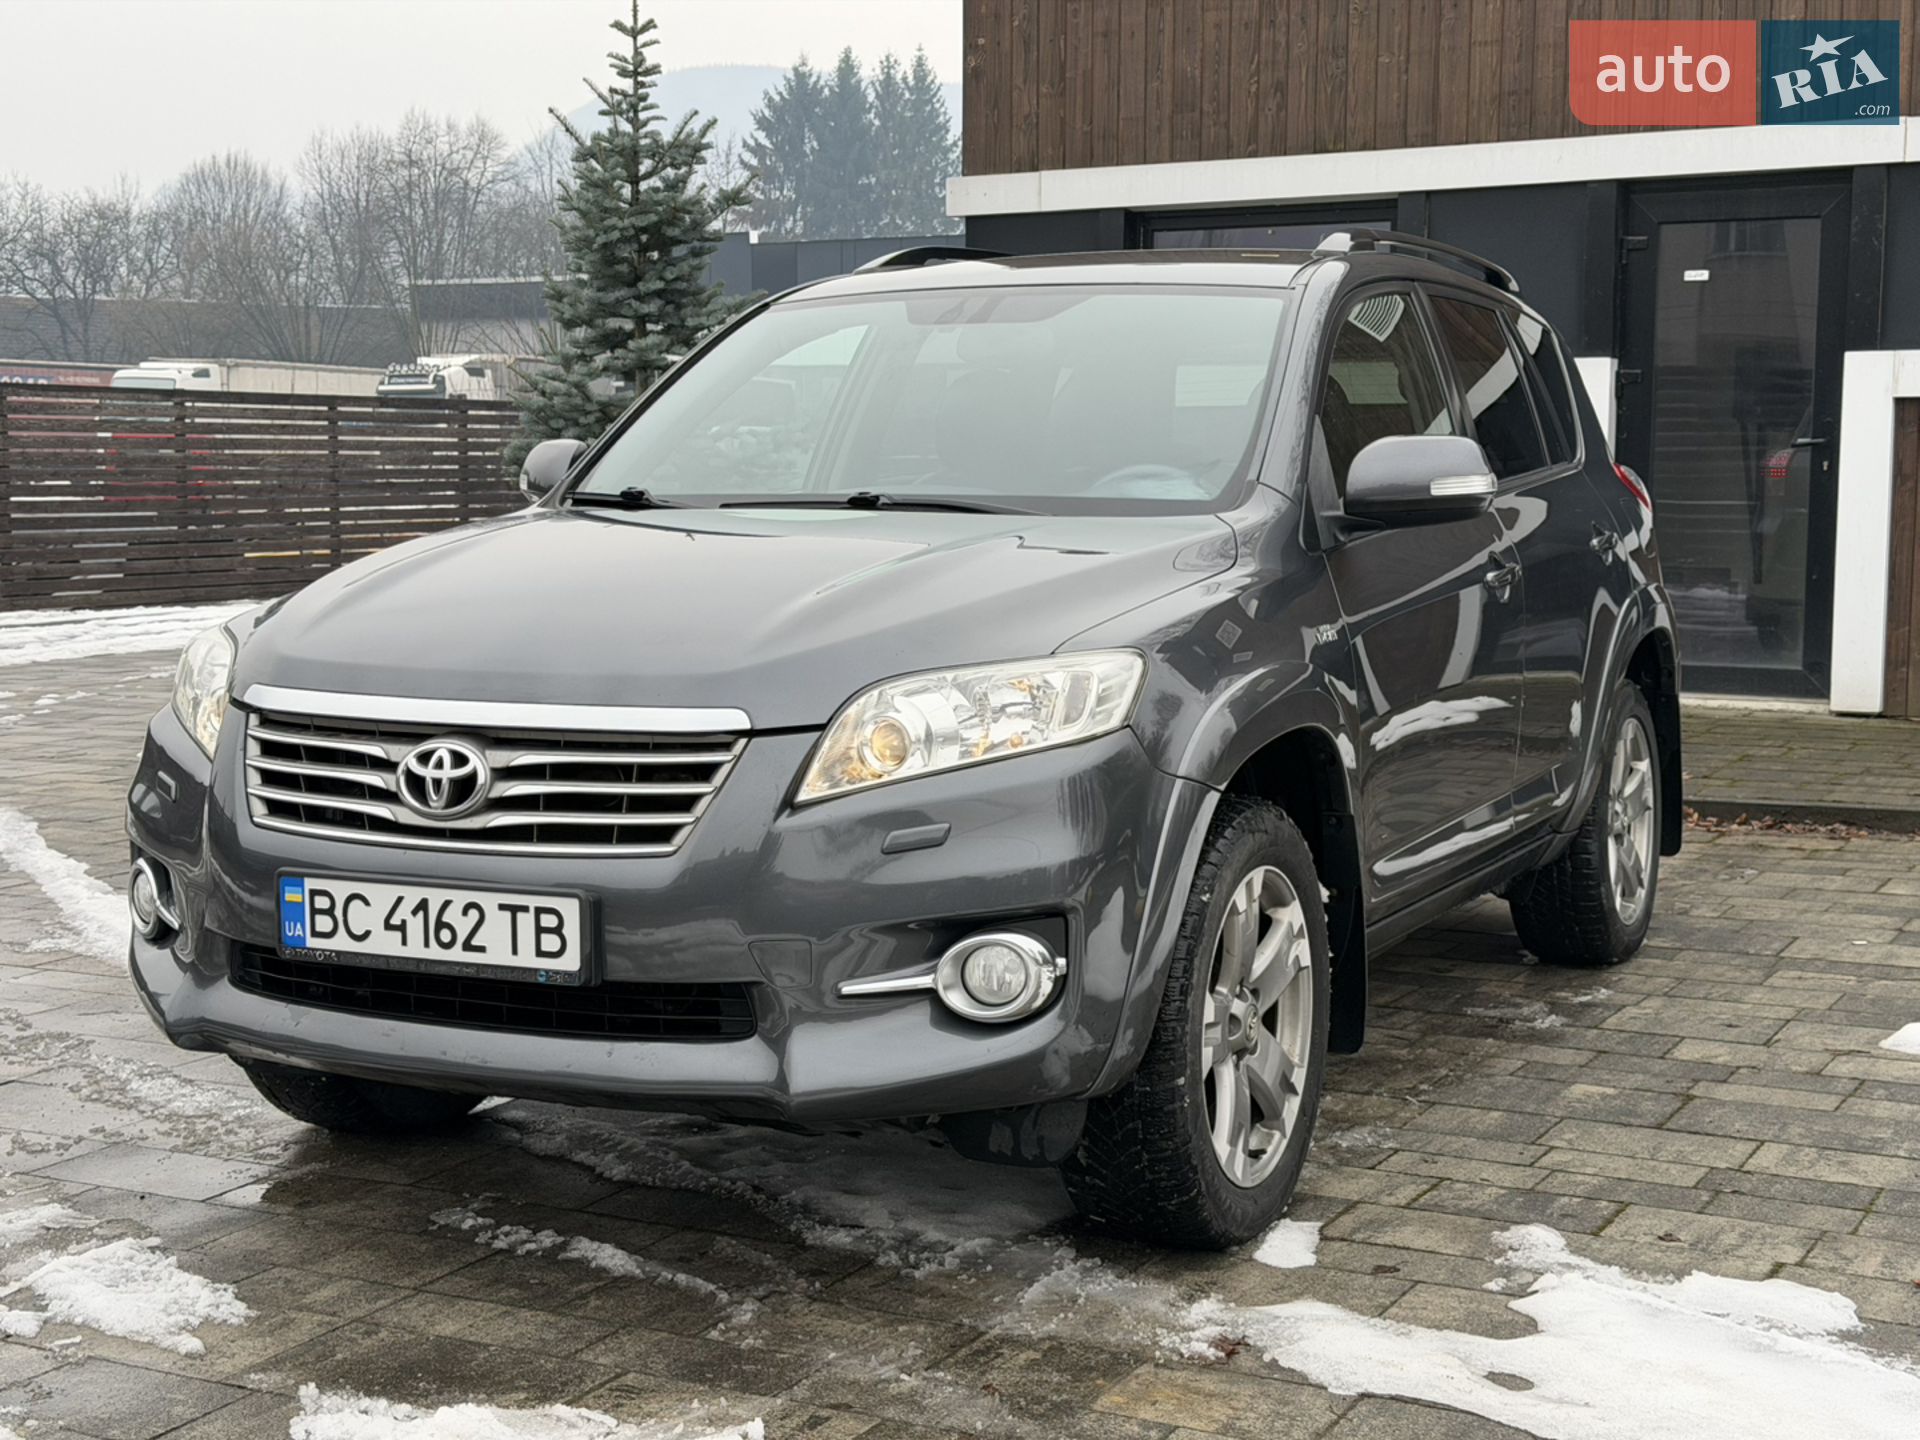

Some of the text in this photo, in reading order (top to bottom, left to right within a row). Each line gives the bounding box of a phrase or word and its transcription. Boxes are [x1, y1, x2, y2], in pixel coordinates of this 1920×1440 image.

[285, 921, 305, 937] UA
[308, 888, 568, 960] BC 4162 TB
